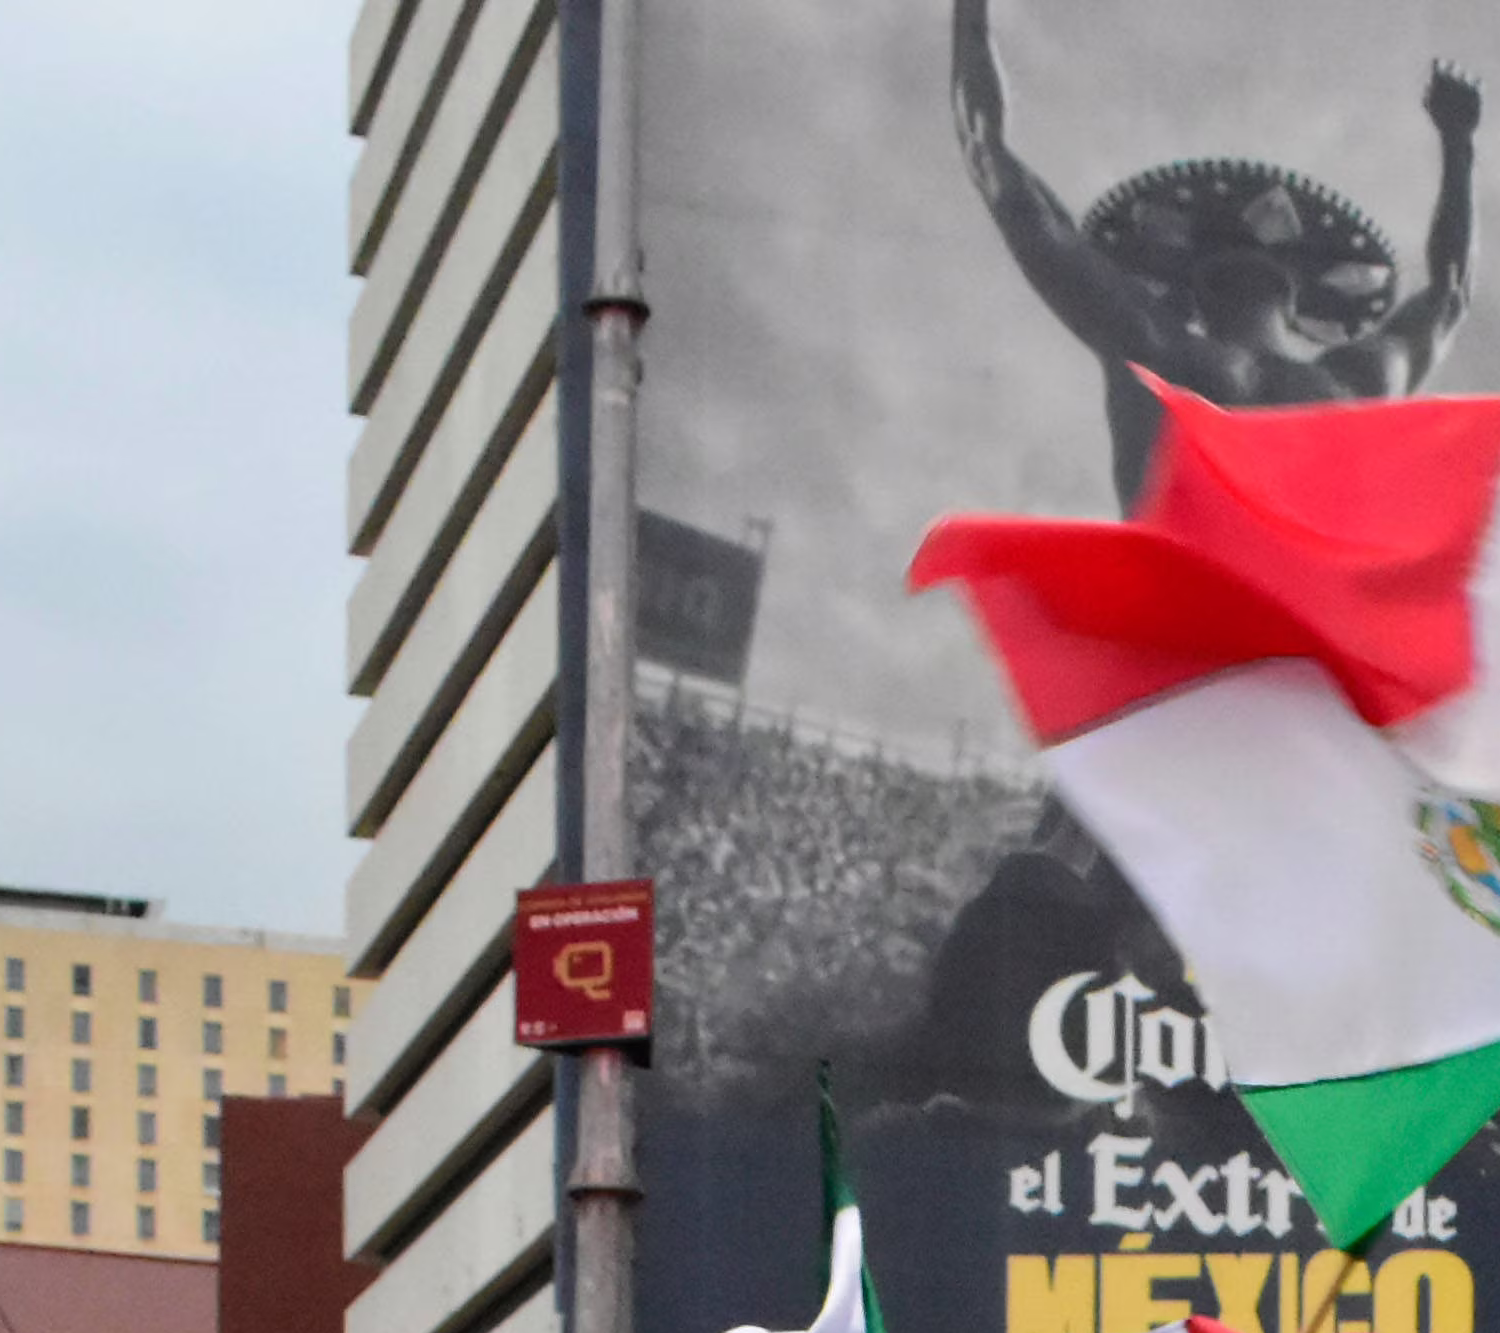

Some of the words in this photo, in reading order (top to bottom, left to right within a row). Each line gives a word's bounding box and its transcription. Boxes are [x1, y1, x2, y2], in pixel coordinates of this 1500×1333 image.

[1009, 1151, 1064, 1215] el
[1088, 1132, 1326, 1238] Extr
[1391, 1186, 1458, 1241] de
